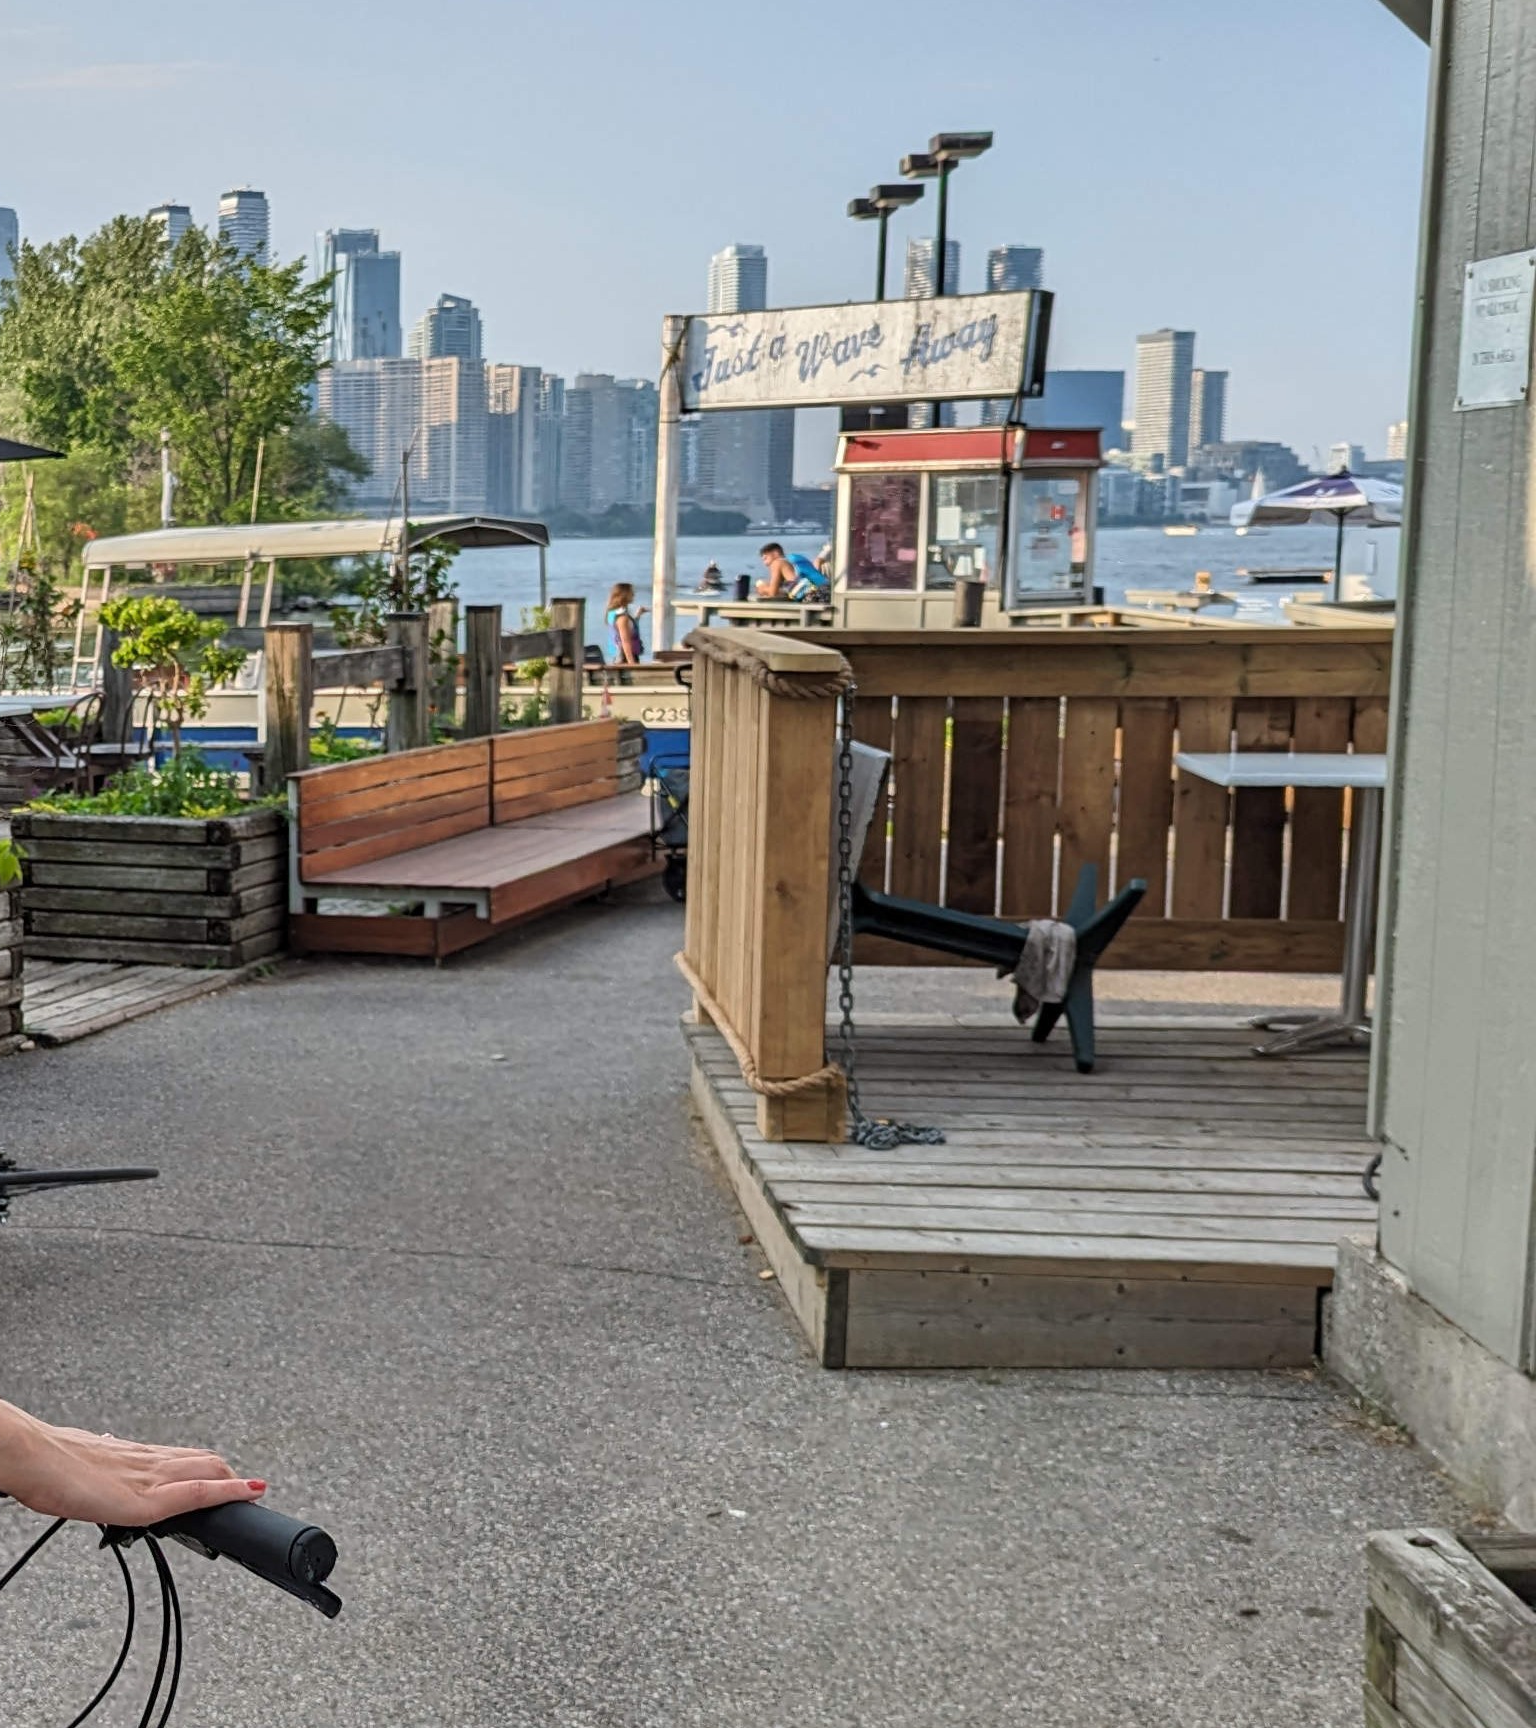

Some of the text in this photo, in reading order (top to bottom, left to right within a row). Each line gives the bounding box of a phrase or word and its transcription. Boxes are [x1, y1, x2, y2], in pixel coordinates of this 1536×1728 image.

[691, 313, 998, 392] Just a Wave Away
